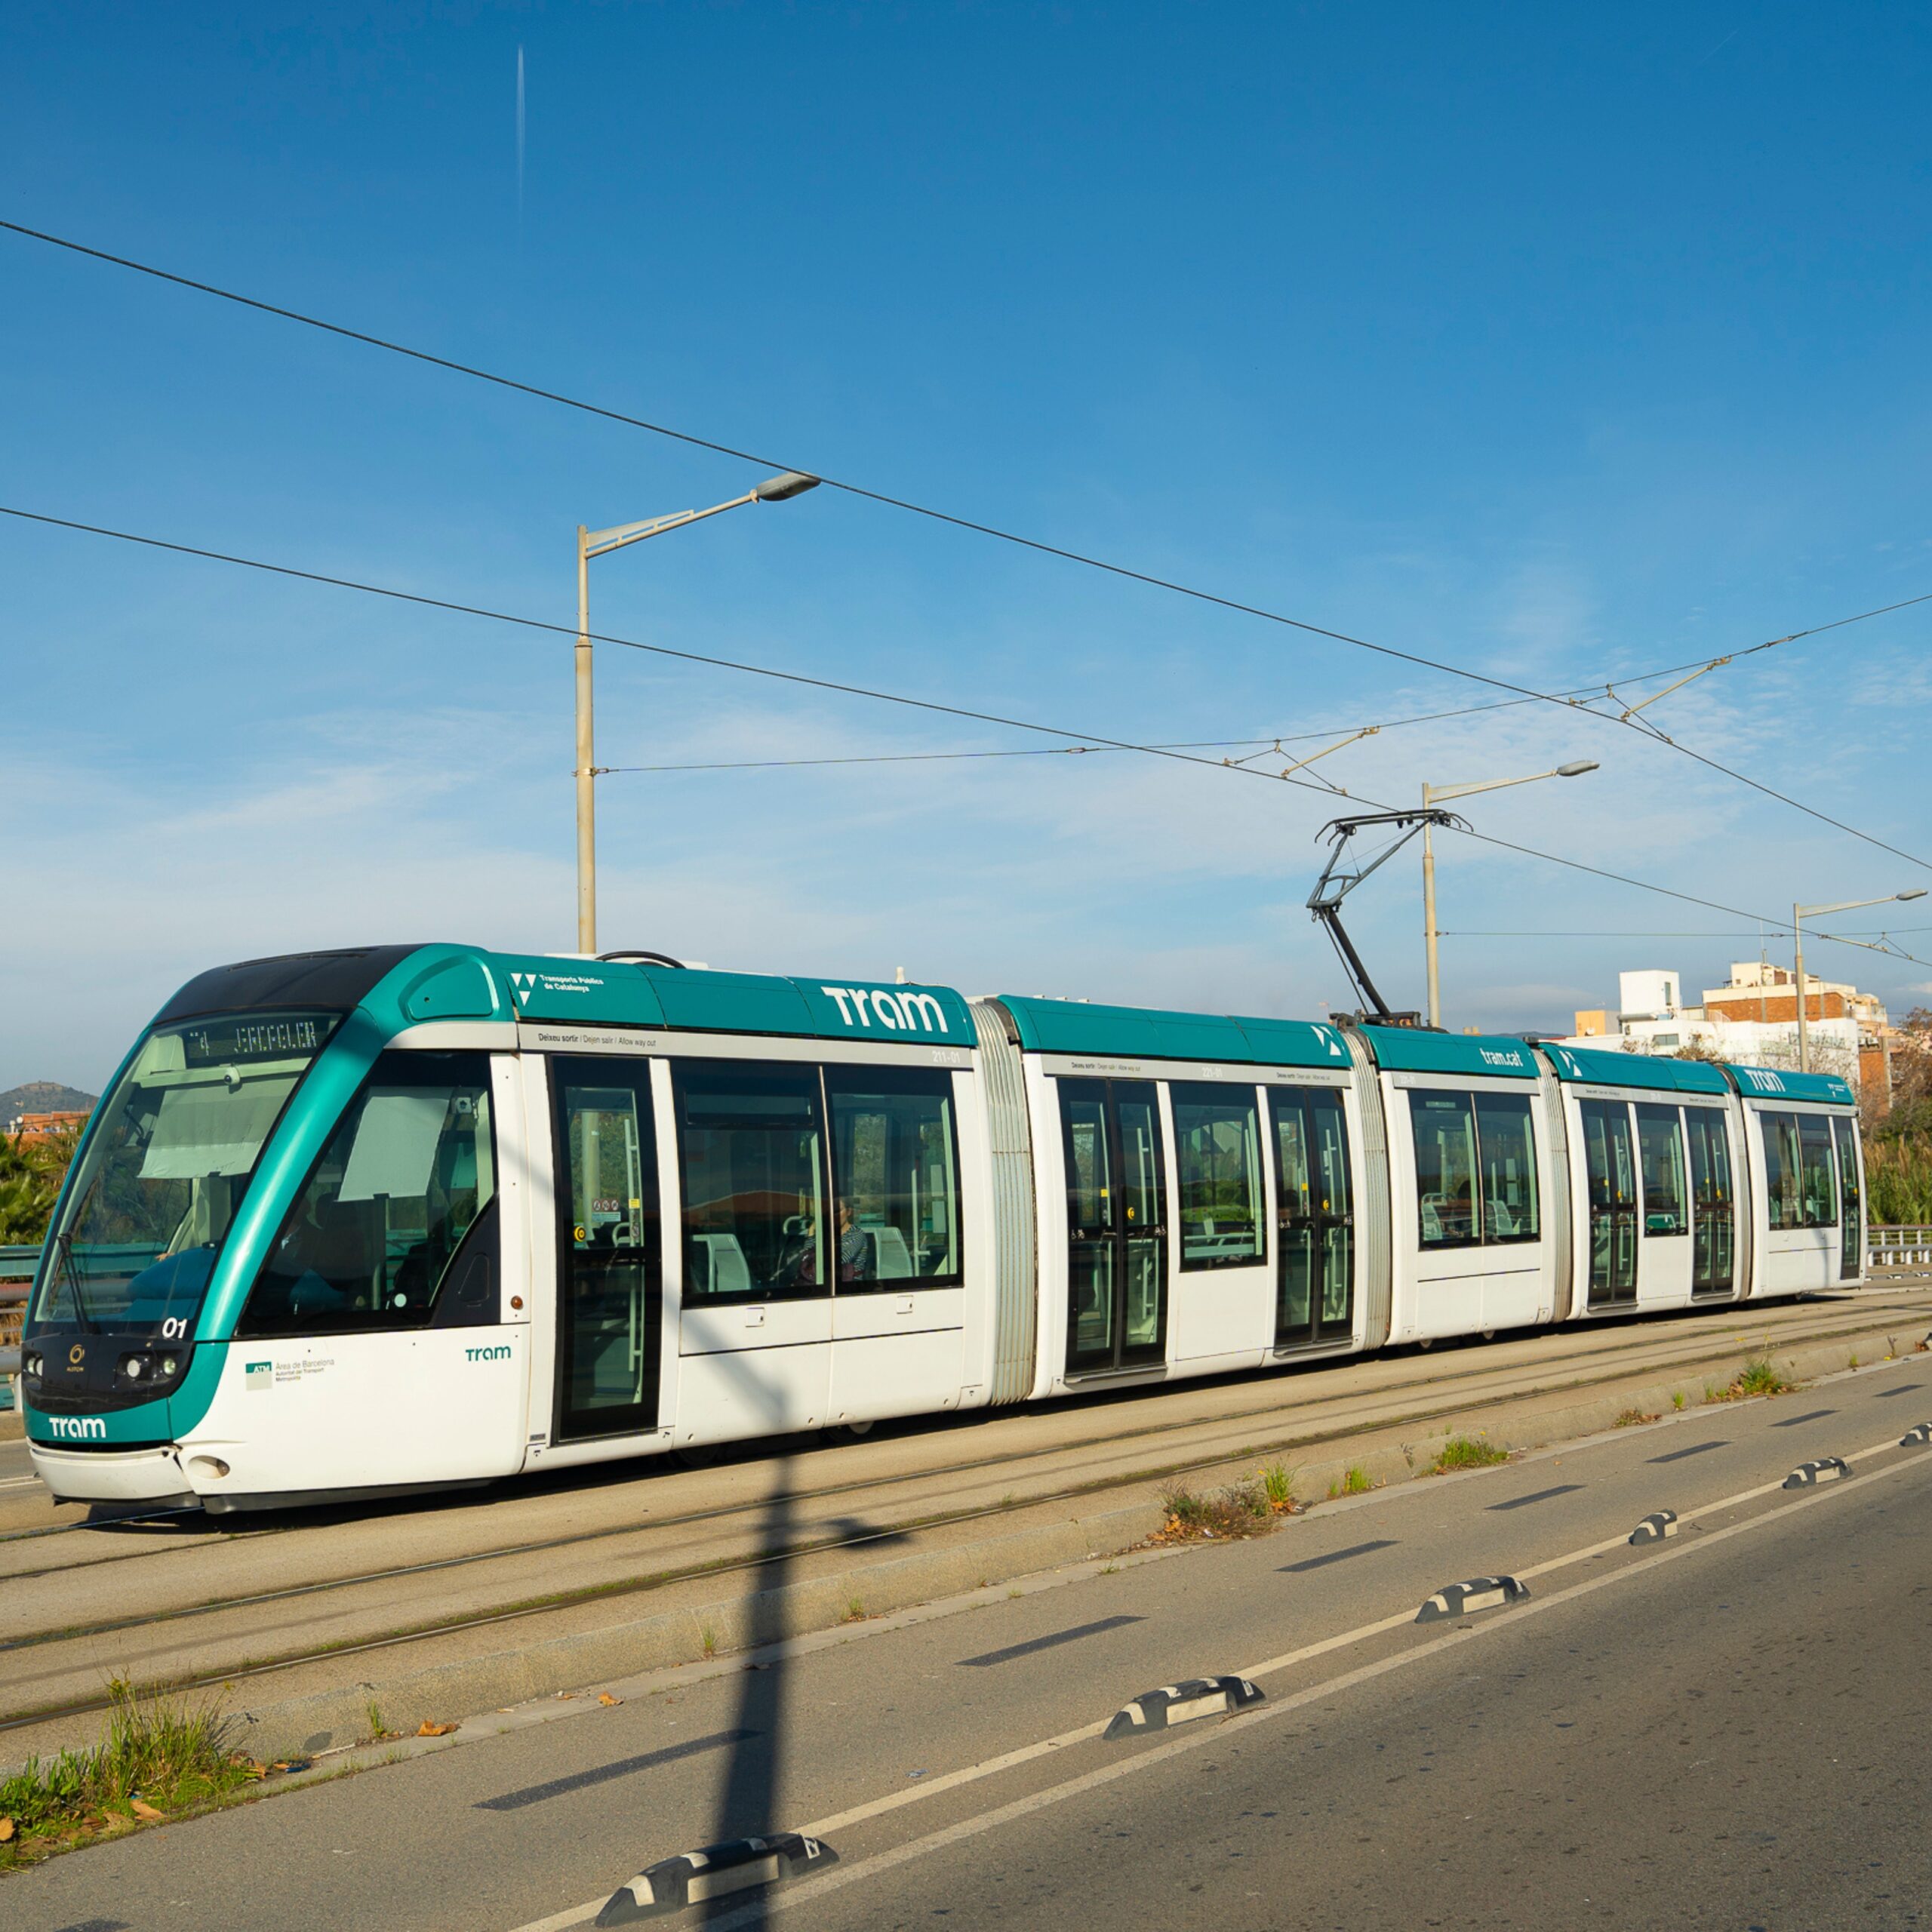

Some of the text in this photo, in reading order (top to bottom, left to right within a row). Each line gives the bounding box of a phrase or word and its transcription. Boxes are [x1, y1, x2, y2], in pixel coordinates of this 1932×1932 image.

[538, 1032, 561, 1042] Deixeu
[562, 1034, 578, 1043] sortir
[583, 1035, 600, 1044] Dejen
[601, 1035, 614, 1044] salir
[619, 1037, 633, 1045] Allow
[1480, 1047, 1524, 1067] tram.cat
[162, 1317, 188, 1339] 01
[302, 1358, 334, 1367] Barcelona
